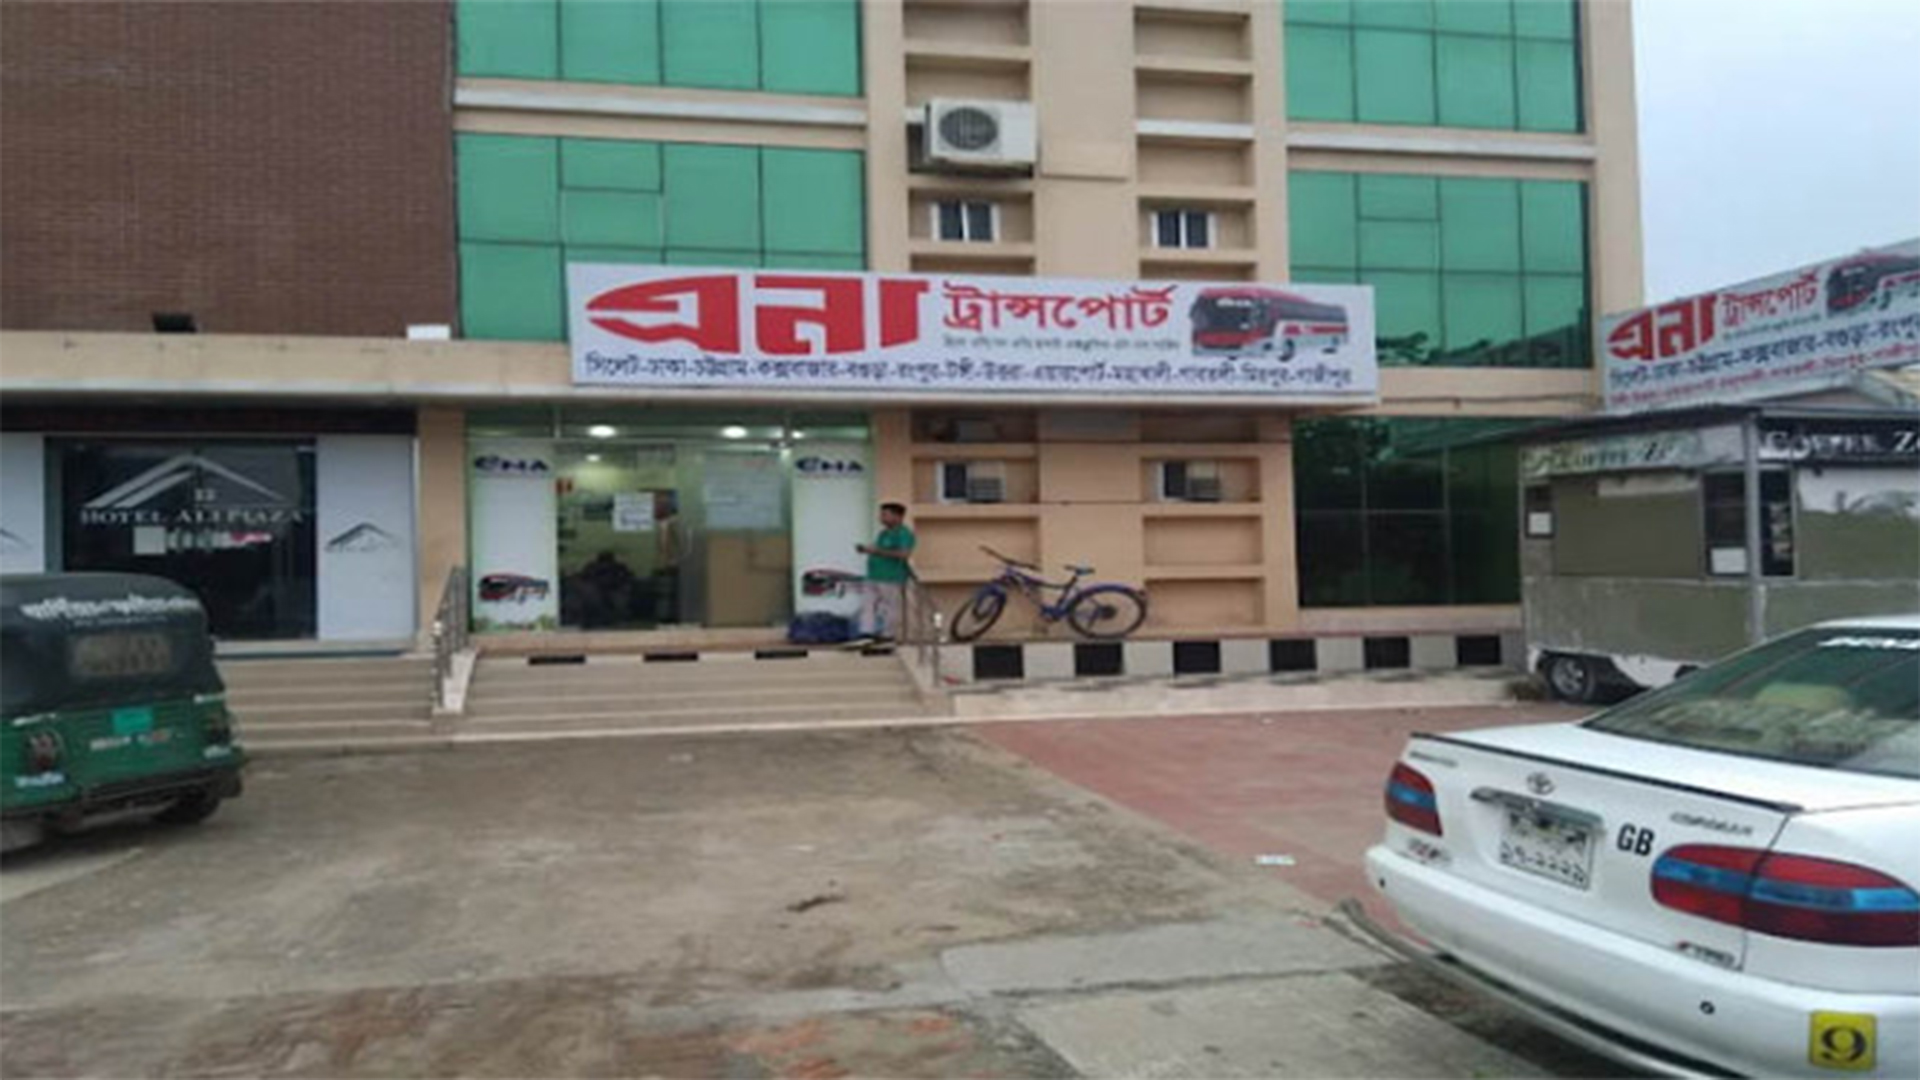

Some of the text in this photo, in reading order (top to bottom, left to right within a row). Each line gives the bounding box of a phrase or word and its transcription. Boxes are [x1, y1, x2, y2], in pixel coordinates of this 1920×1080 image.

[585, 274, 1179, 355] এনা ট্রান্সপোর্ট
[1605, 293, 1719, 362] এনা
[1616, 822, 1656, 857] GB
[1820, 1025, 1867, 1066] 9
